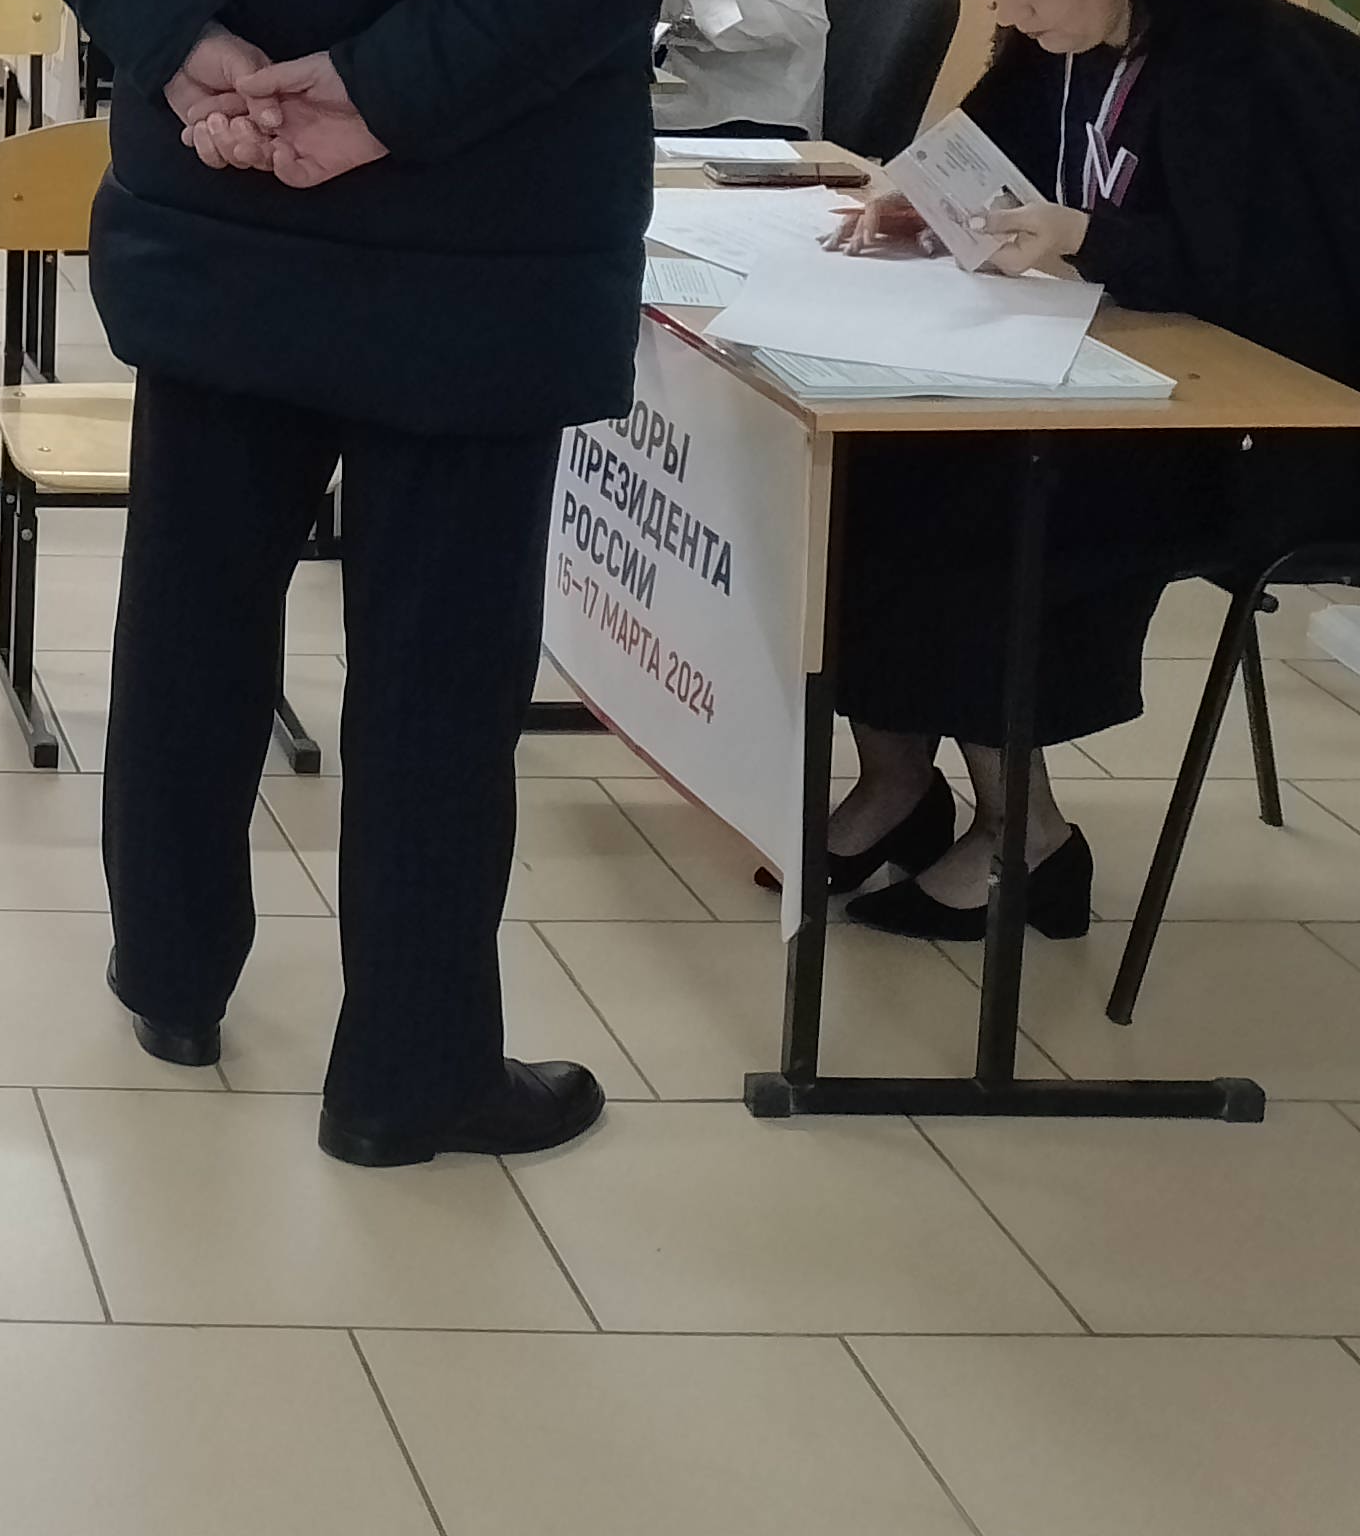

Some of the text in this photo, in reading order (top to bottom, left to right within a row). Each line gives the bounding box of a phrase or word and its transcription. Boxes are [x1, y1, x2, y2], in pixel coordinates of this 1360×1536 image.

[608, 400, 690, 483] ОРЫ
[561, 490, 657, 611] РОССИИ
[569, 427, 732, 596] ПРЕЗИДЕНТА
[600, 592, 661, 681] МАРТА
[665, 650, 714, 724] 2024
